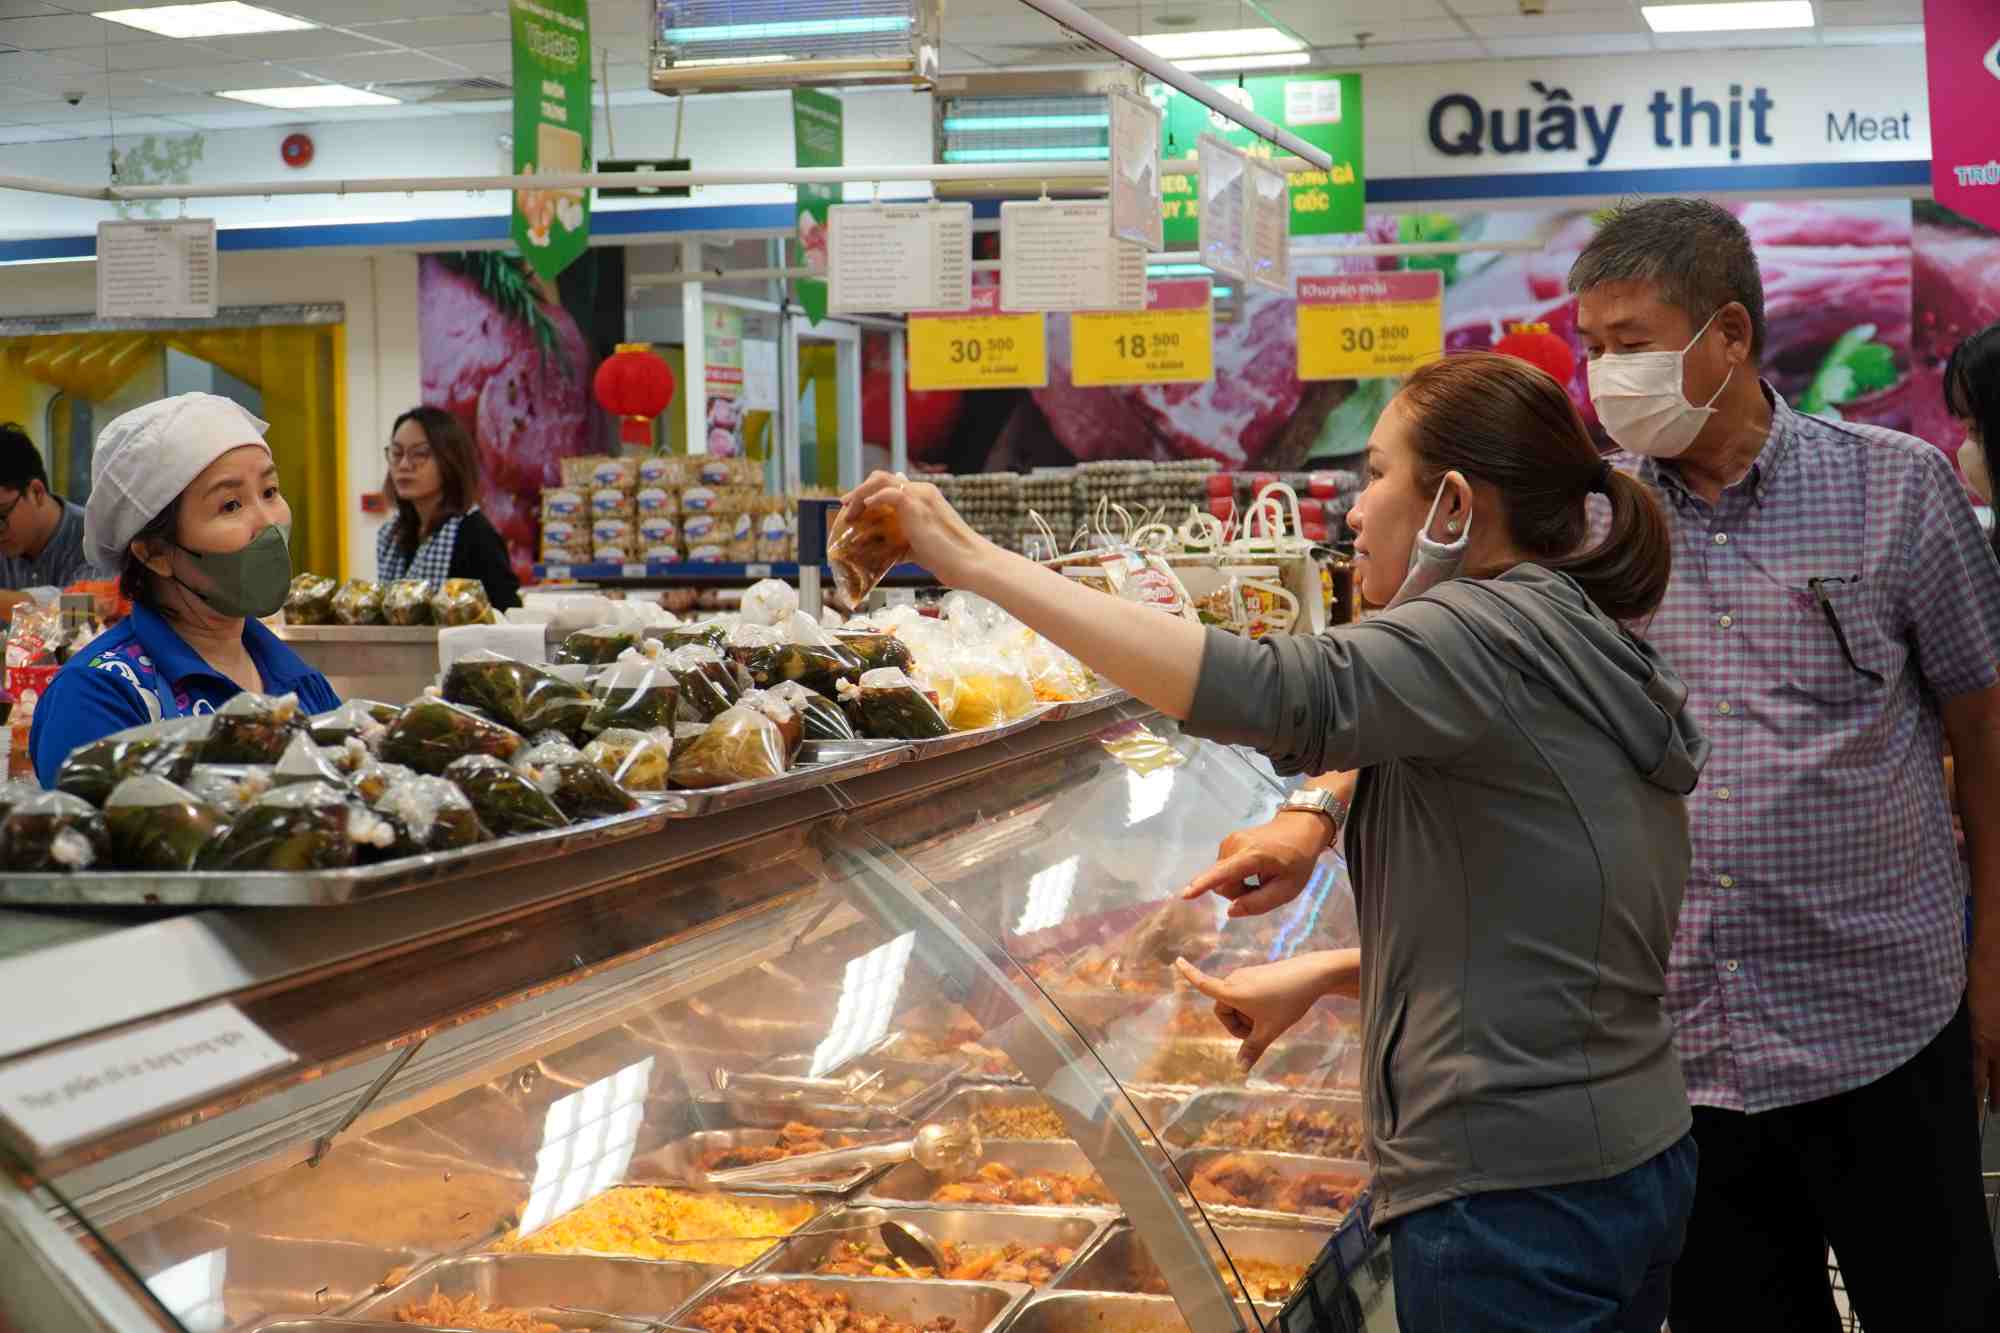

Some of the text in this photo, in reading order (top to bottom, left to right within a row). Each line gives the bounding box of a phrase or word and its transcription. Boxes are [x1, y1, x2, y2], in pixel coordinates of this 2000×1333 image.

[1427, 81, 1624, 166] Quầy
[1648, 85, 1775, 160] thịt
[1826, 110, 1912, 145] Meat
[951, 338, 981, 363] 30
[1115, 333, 1146, 358] 18
[1341, 327, 1374, 352] 30
